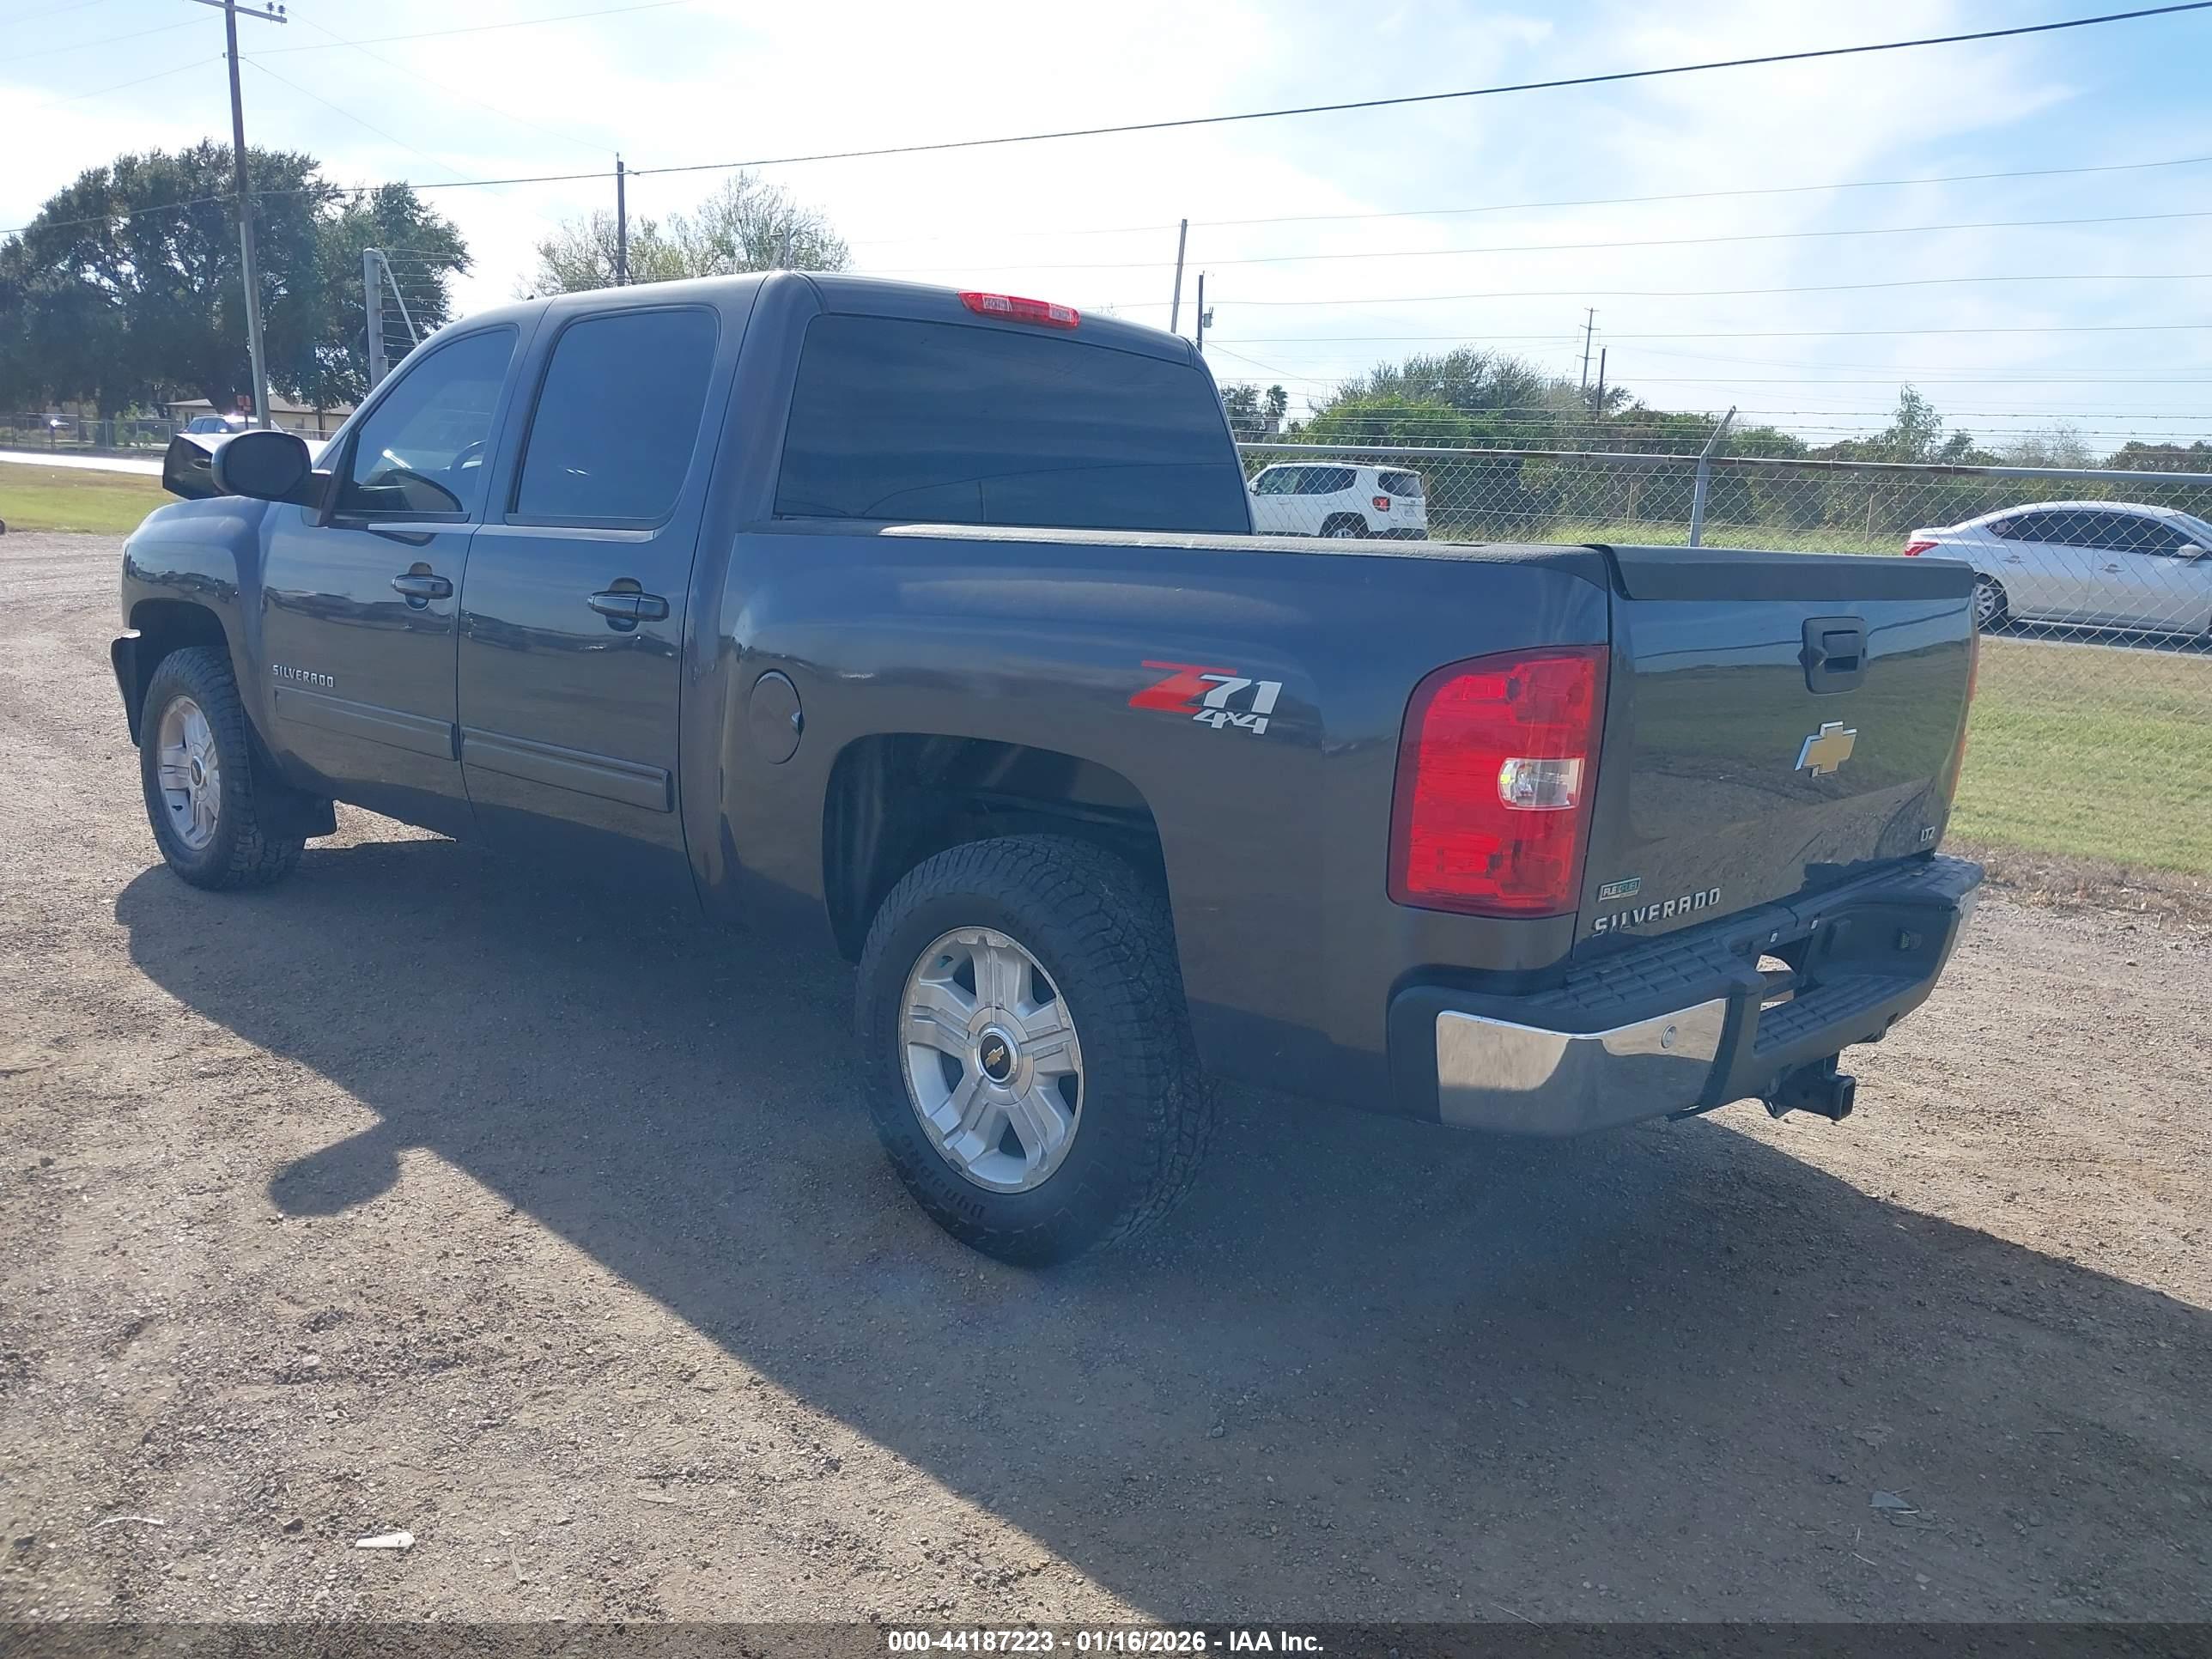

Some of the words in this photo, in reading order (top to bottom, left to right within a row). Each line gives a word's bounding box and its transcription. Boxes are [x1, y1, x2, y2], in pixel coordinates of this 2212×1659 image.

[272, 665, 334, 688] SILVERADO
[1128, 659, 1283, 714] Z71
[1592, 887, 1721, 938] SILVERADO
